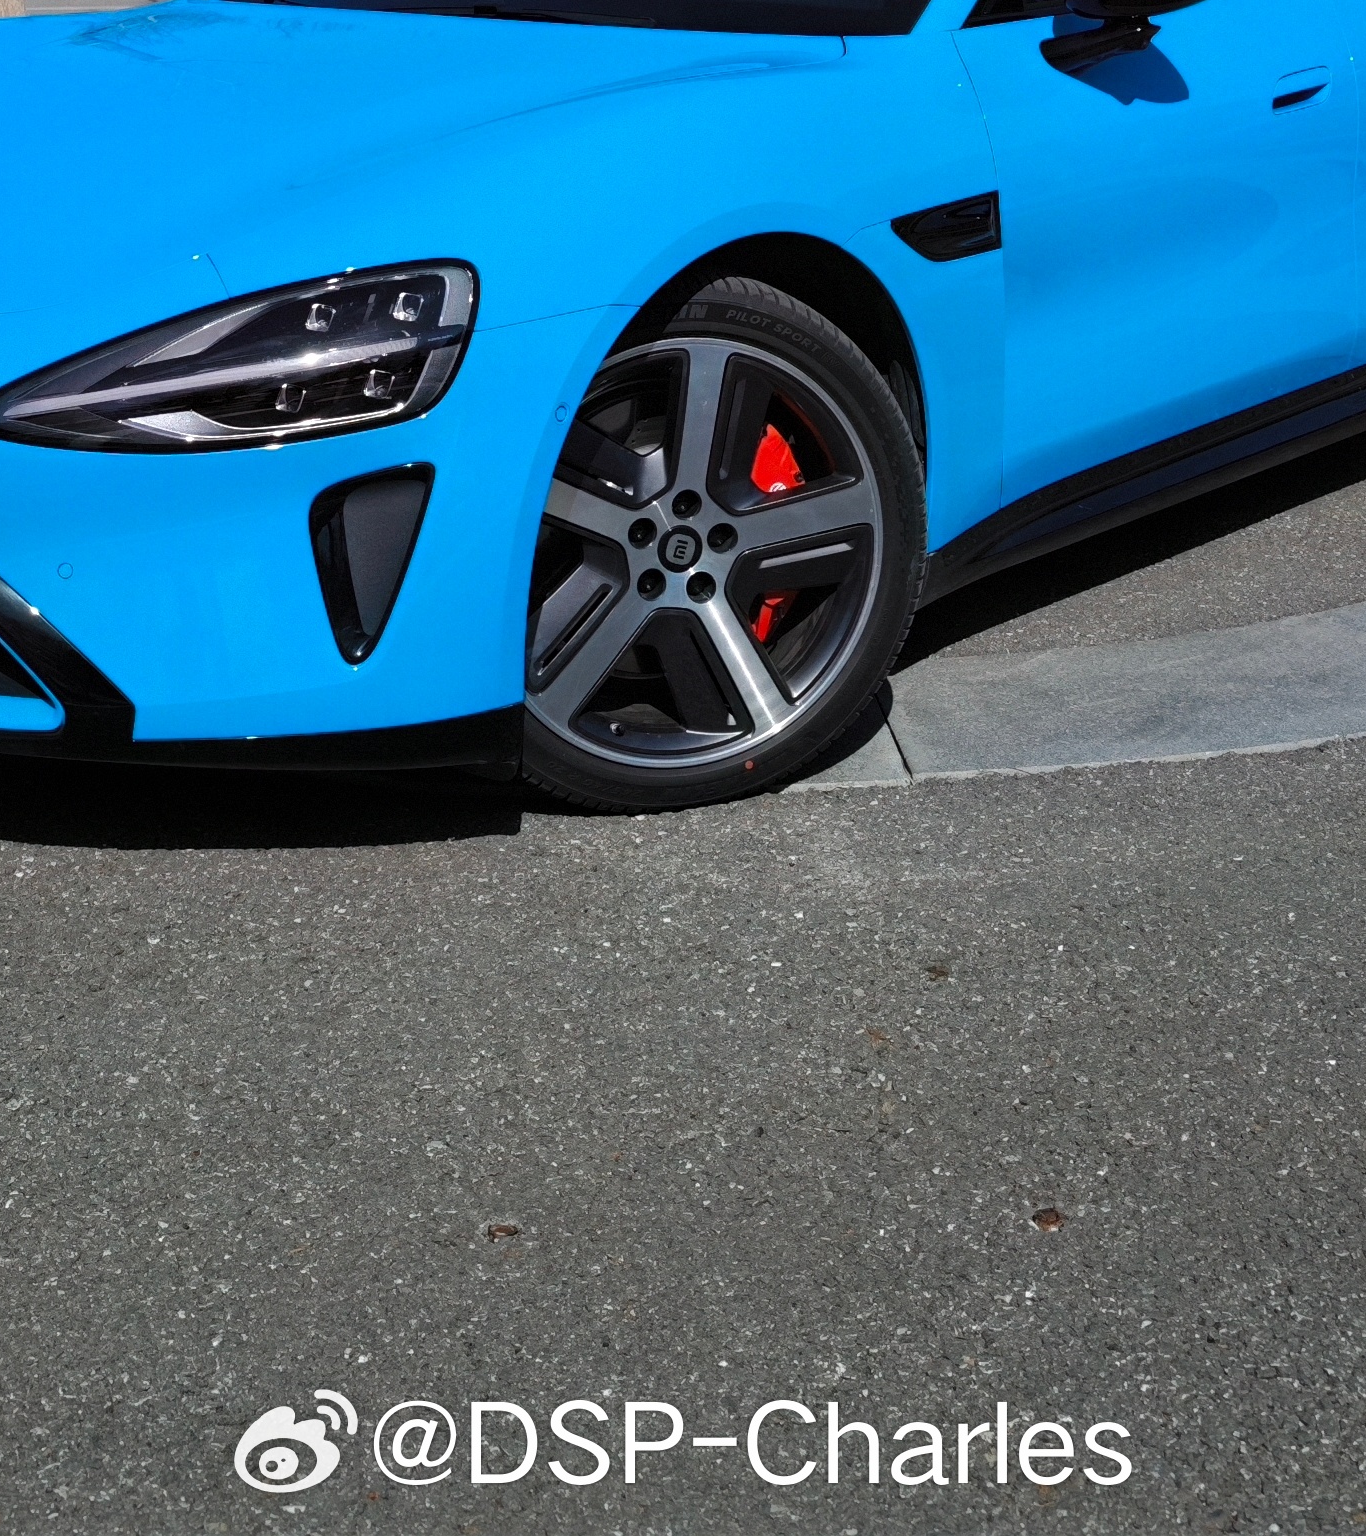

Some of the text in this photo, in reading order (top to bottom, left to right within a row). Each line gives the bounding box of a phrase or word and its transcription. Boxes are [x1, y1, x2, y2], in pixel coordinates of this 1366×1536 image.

[672, 304, 709, 319] IN
[726, 309, 772, 328] PILOT
[773, 323, 822, 352] SPORT
